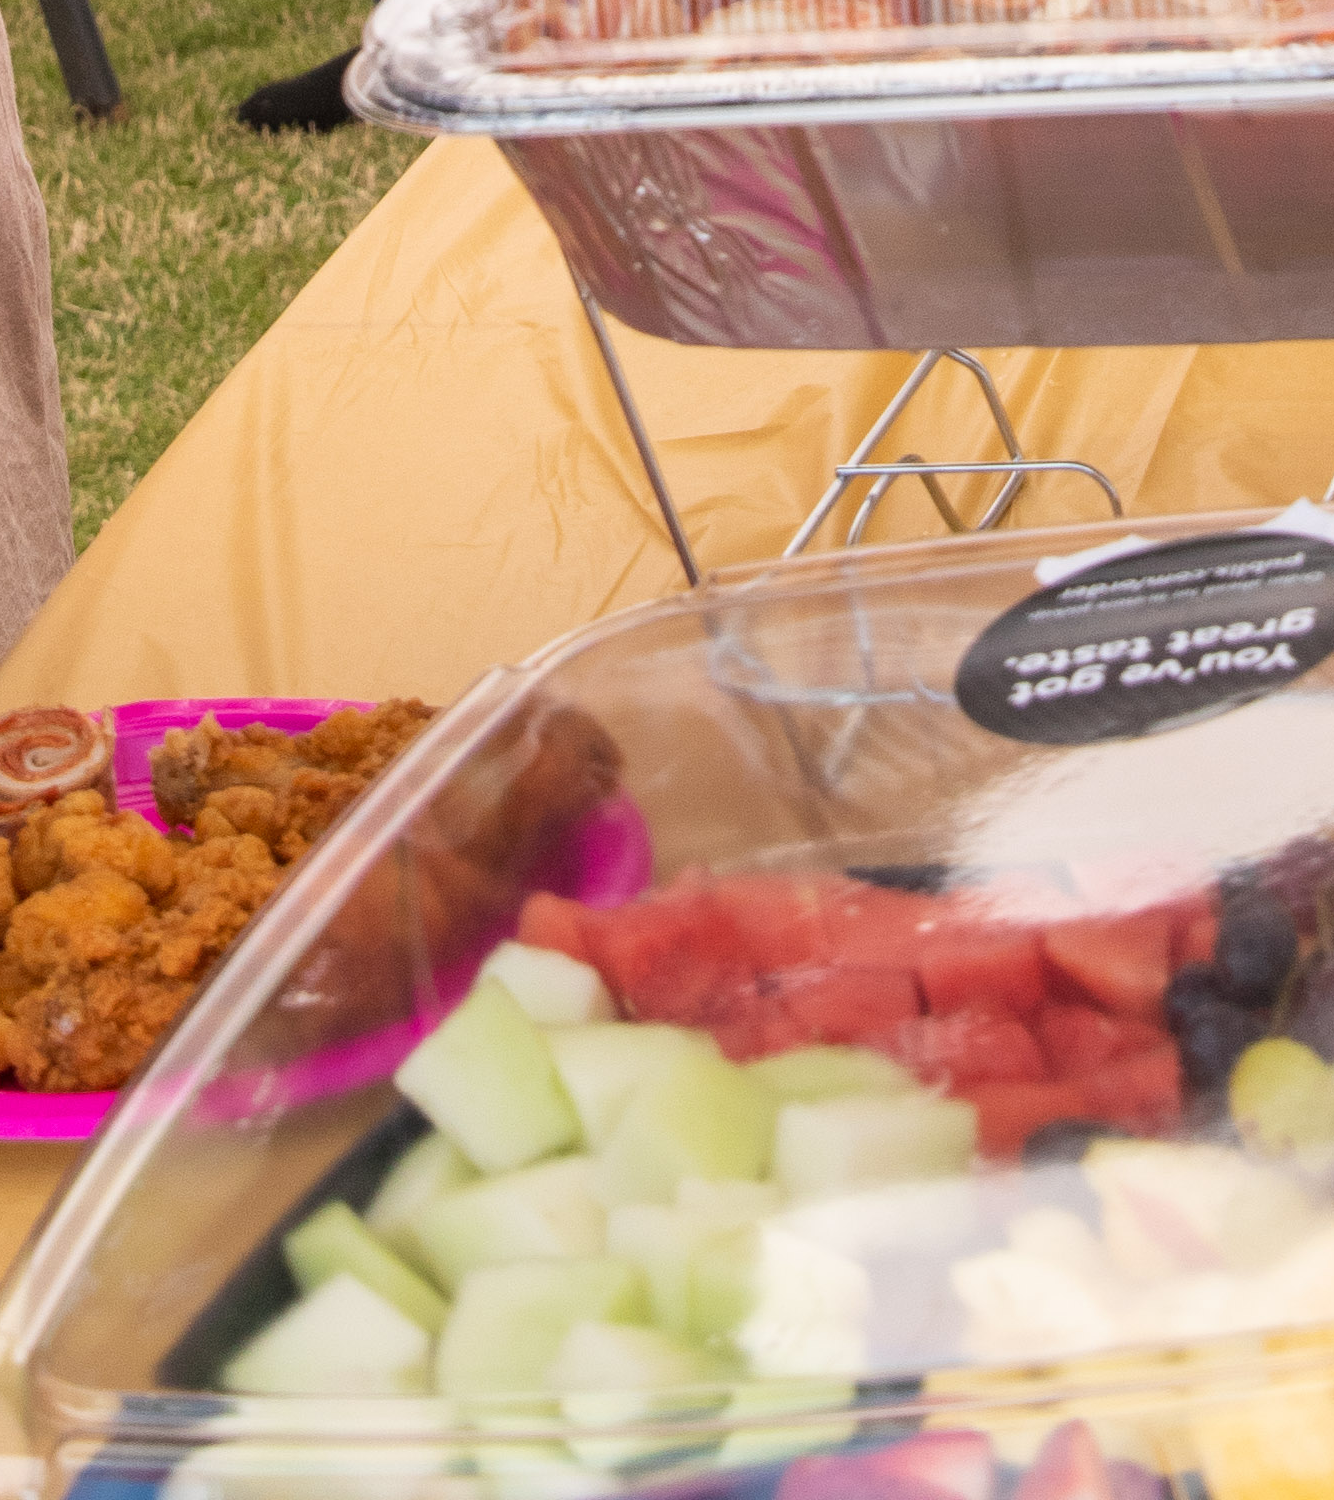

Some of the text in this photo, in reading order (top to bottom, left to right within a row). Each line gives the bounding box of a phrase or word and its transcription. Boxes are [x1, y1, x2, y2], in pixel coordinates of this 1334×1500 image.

[1003, 606, 1317, 676] great taste.
[1007, 642, 1299, 710] You've got
